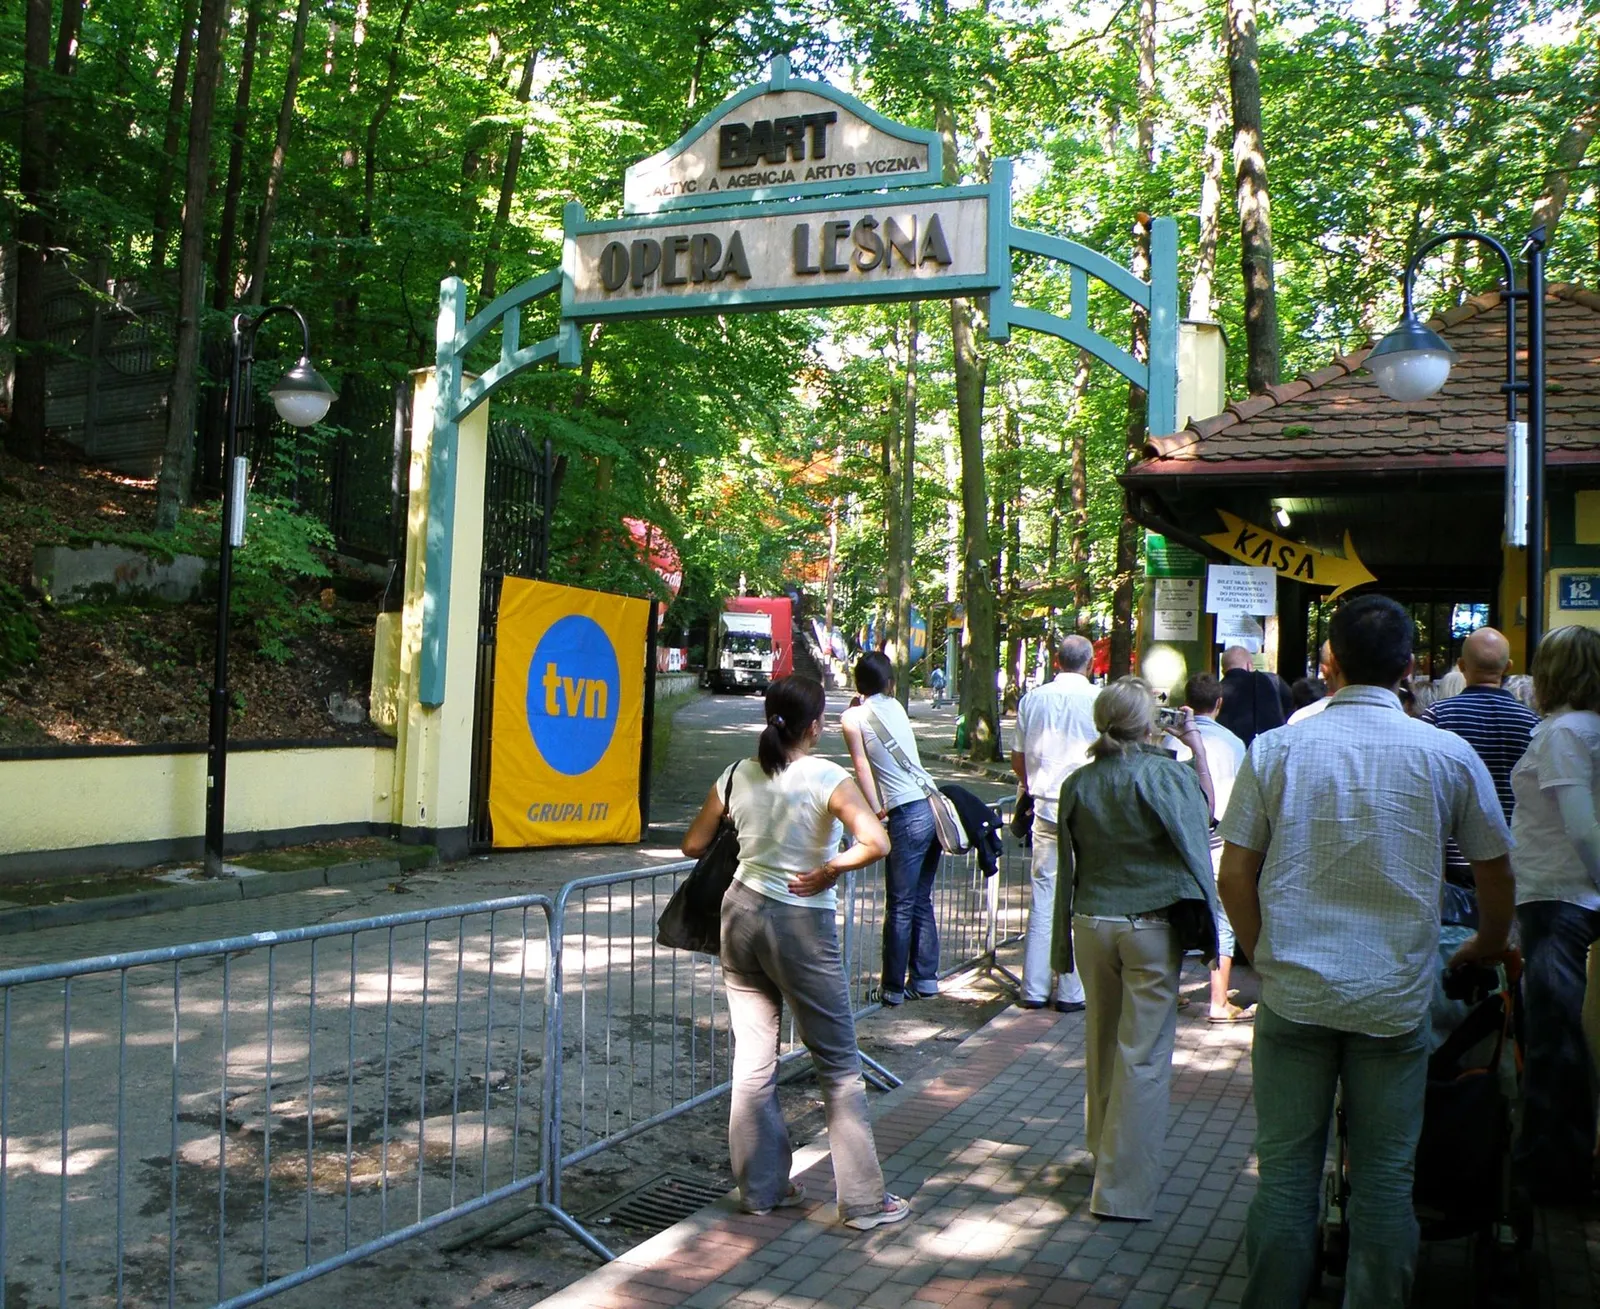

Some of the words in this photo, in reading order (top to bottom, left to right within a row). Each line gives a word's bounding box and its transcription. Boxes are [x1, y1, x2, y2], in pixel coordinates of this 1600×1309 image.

[719, 111, 837, 169] BART
[727, 170, 796, 189] AGENCJA
[805, 157, 921, 181] ARTYSYCZNA
[600, 229, 752, 292] OPERA
[1233, 528, 1314, 579] KASA
[1569, 582, 1591, 599] 12
[543, 663, 608, 718] tvn
[527, 803, 584, 822] GRUPA
[587, 803, 609, 821] ITI
